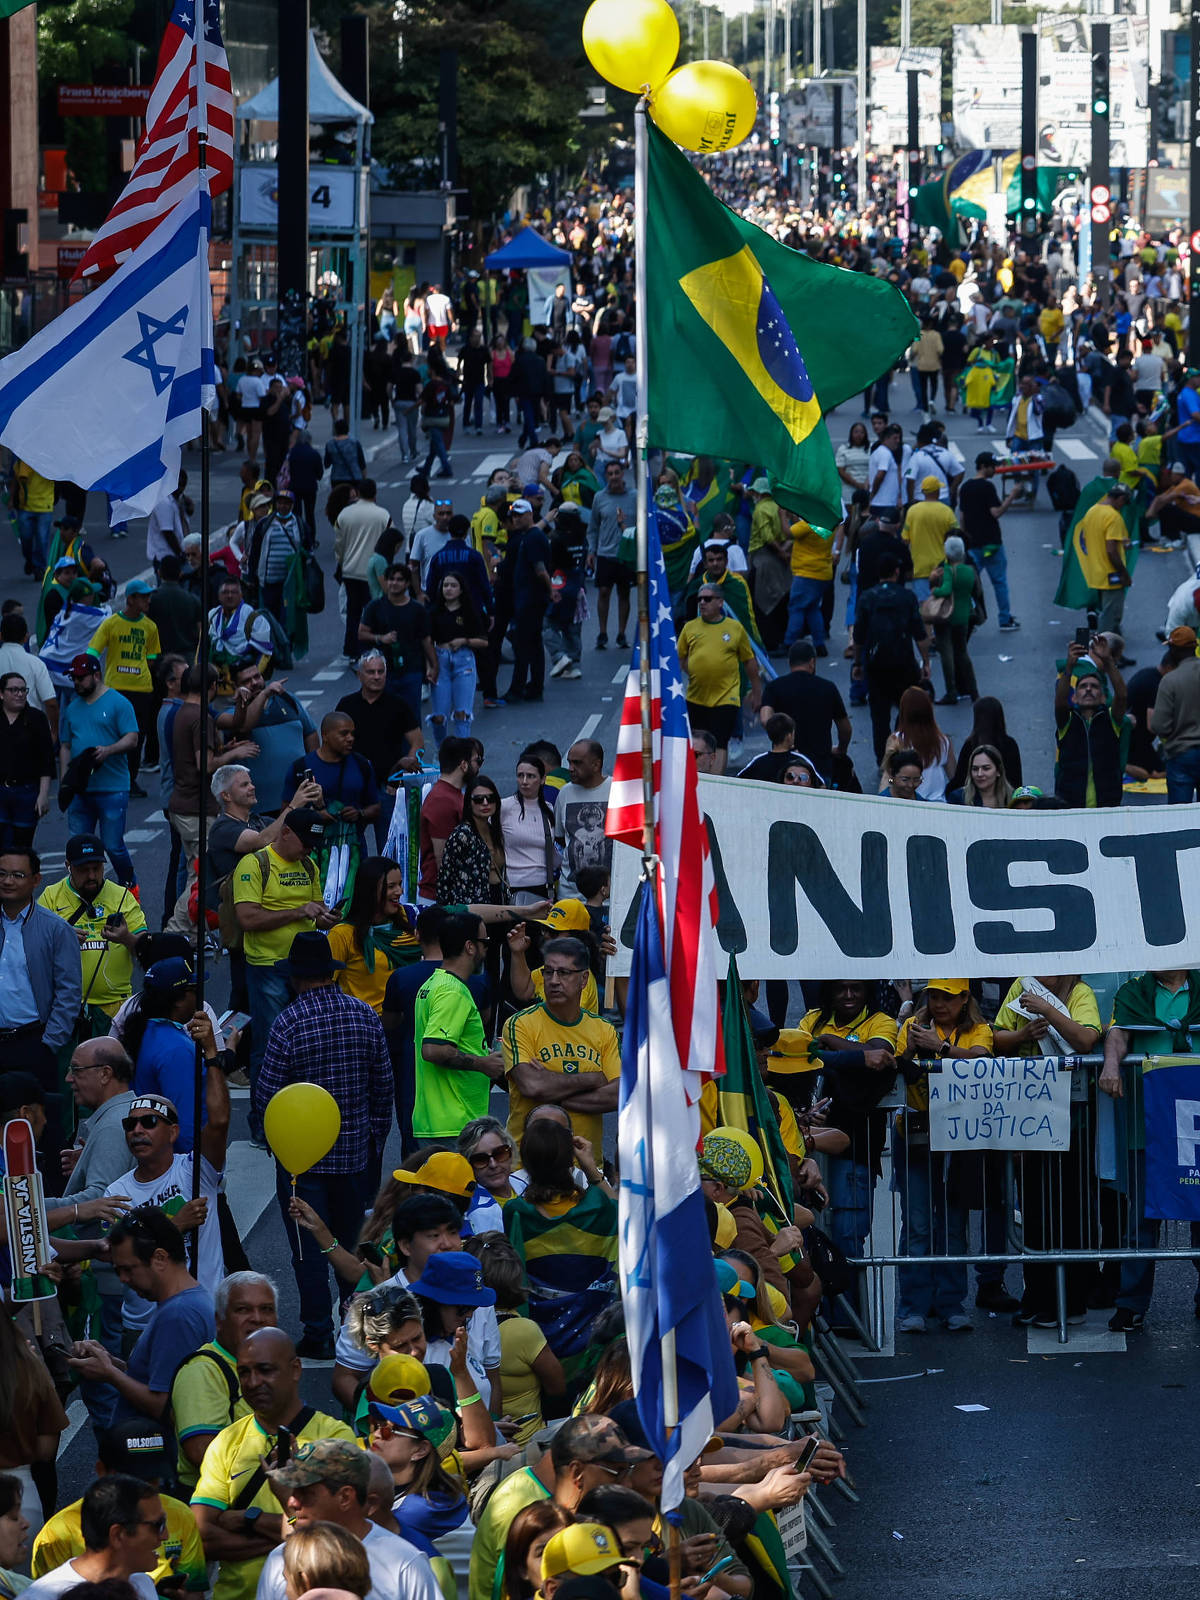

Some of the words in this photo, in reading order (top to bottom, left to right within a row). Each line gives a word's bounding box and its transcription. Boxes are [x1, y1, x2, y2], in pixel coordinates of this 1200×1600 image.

[311, 186, 331, 208] 4
[540, 1043, 601, 1067] BRASIL
[951, 1058, 1057, 1082] CONTRA
[930, 1086, 940, 1100] A
[948, 1081, 1053, 1102] INJUSTIÇA
[982, 1101, 1005, 1116] DA
[11, 1177, 30, 1204] JÁ
[18, 1204, 39, 1276] ANISTIA
[127, 1436, 163, 1449] BOLSO
